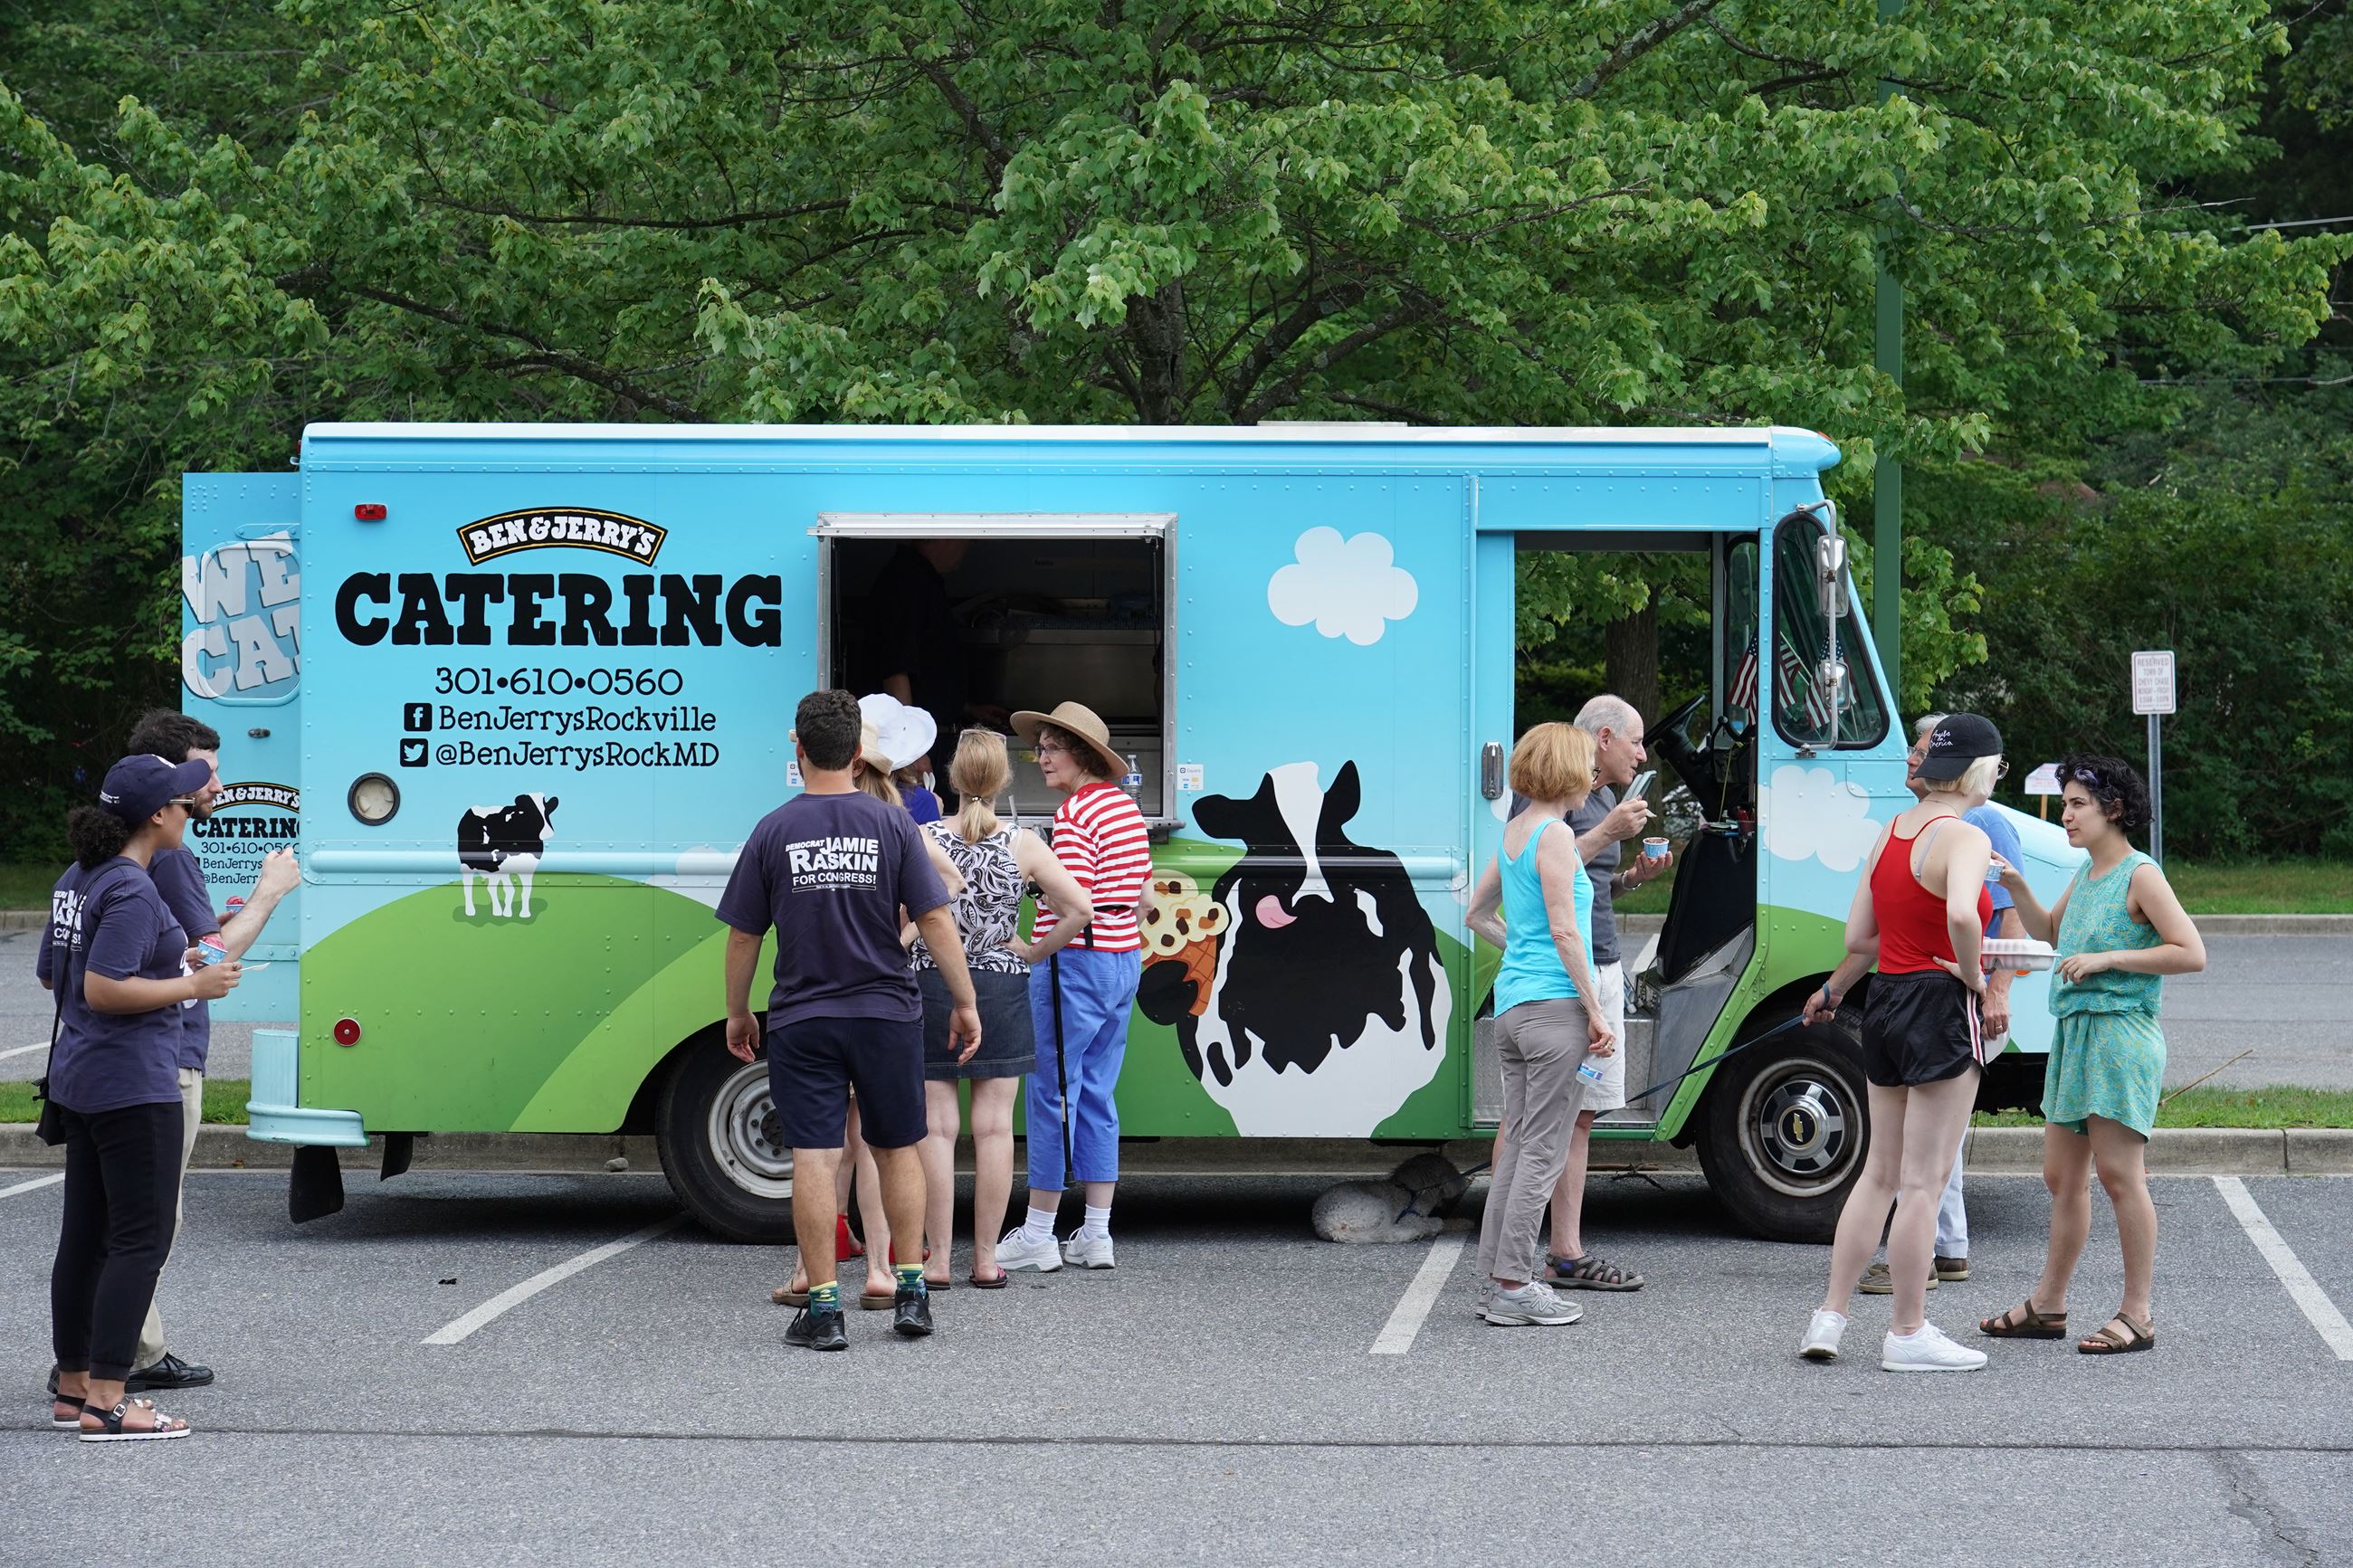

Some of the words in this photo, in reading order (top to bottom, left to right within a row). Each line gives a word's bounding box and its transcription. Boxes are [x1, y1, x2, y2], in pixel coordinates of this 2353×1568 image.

[335, 572, 782, 648] CATERING
[2138, 658, 2168, 666] RESERVED
[439, 705, 717, 736] BenJerrysRockville
[435, 740, 719, 772] @BenJerrysRockMD
[192, 817, 300, 838] CATERIN
[786, 840, 825, 851] DEMOCRAT
[819, 837, 879, 855] JAMIE
[789, 849, 878, 874] RASKIN
[204, 873, 260, 884] @BenJerr
[793, 873, 816, 886] FOR
[817, 872, 876, 884] CONGRESS!
